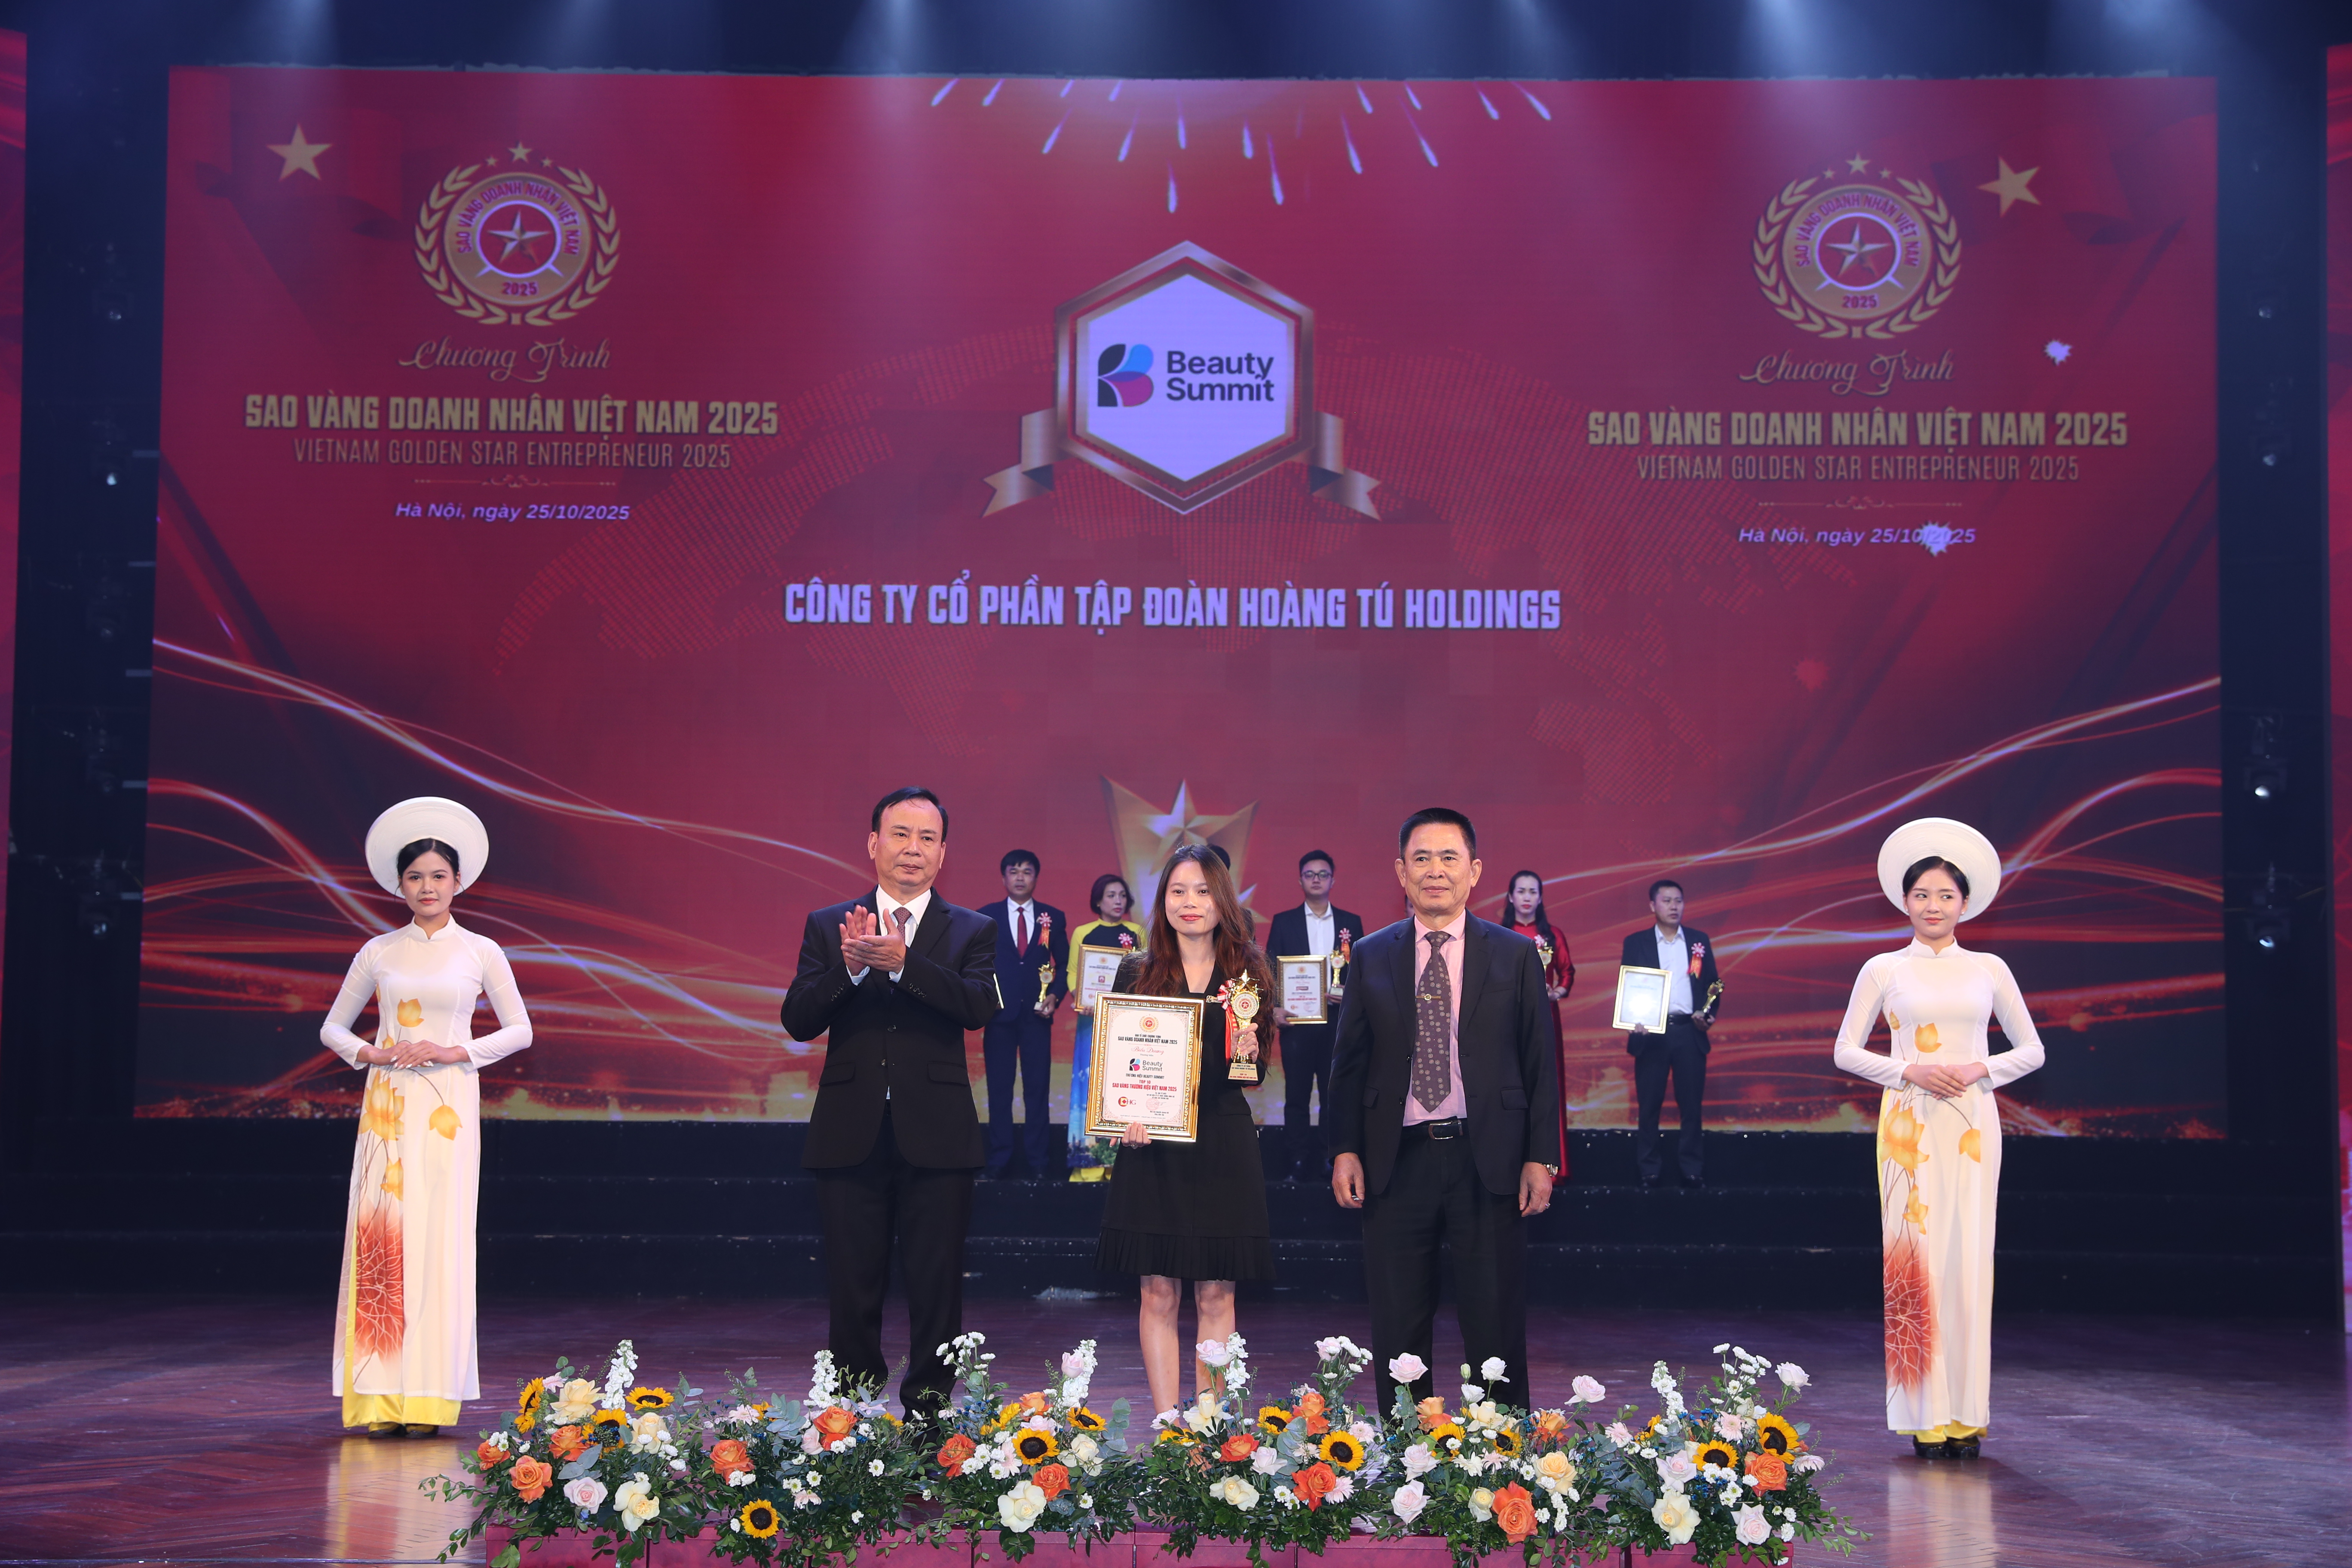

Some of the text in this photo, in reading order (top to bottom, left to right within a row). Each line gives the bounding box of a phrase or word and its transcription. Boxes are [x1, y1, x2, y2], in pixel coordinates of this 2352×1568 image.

[456, 181, 581, 255] SAO VÀNG DOANH NHÂN VIỆT NAM
[1795, 193, 1921, 267] SAO VÀNG DOANH NHÂN VIỆT NAM
[502, 281, 538, 295] 2025
[1842, 294, 1879, 309] 2025
[398, 335, 611, 382] Chương Trình
[1167, 351, 1274, 380] Beauty
[1739, 349, 1954, 395] Chương Trình
[1167, 377, 1274, 401] Summit
[245, 389, 778, 441] SAO VÀNG DOANH NHÂN VIỆT NAM 2025
[1588, 405, 2127, 454] SAO VÀNG DOANH NHÂN VIỆT NAM 2025
[294, 438, 730, 468] VIETNAM GOLDEN STAR ENTREPRENEUR 2025
[1637, 456, 2079, 480] VIETNAM GOLDEN STAR ENTREPRENEUR 2025
[395, 502, 630, 522] Hà Nội, ngày 25/10/2025
[1738, 528, 1764, 542] Hà
[1771, 528, 1808, 545] Nội,
[1816, 529, 1865, 547] ngày
[785, 569, 1560, 635] CÔNG TY CỔ PHẦN TẬP ĐOÀN HOÀNG TÚ HOLDINGS
